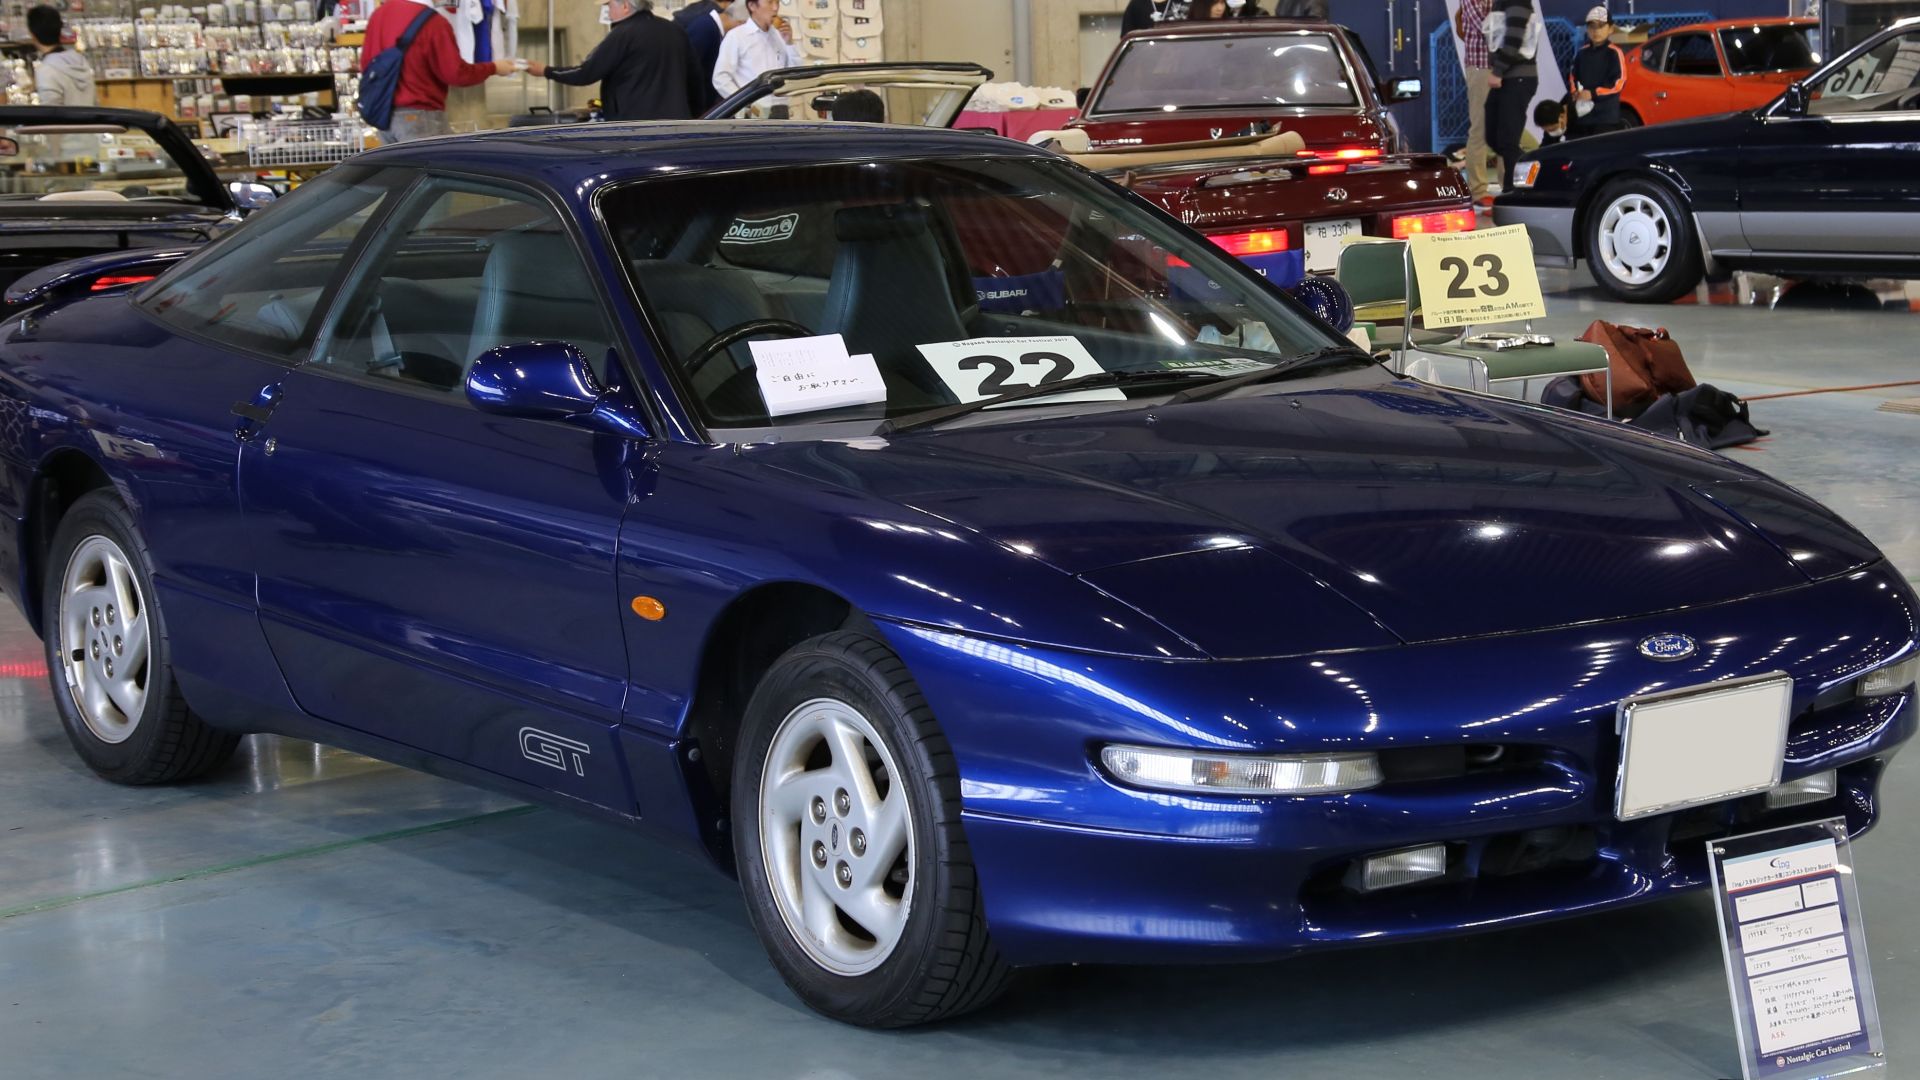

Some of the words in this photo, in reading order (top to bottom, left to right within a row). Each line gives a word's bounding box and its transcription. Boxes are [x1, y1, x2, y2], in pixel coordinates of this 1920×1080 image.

[1435, 186, 1457, 197] M30
[724, 223, 779, 238] oleman
[1440, 253, 1510, 299] 23
[986, 289, 1028, 299] SUBARU
[958, 351, 1075, 396] 22
[1655, 639, 1683, 652] Ford
[519, 726, 590, 777] GT
[1786, 1051, 1815, 1065] Nostalgic
[1815, 1048, 1827, 1057] Car
[1828, 1042, 1851, 1055] Festival
